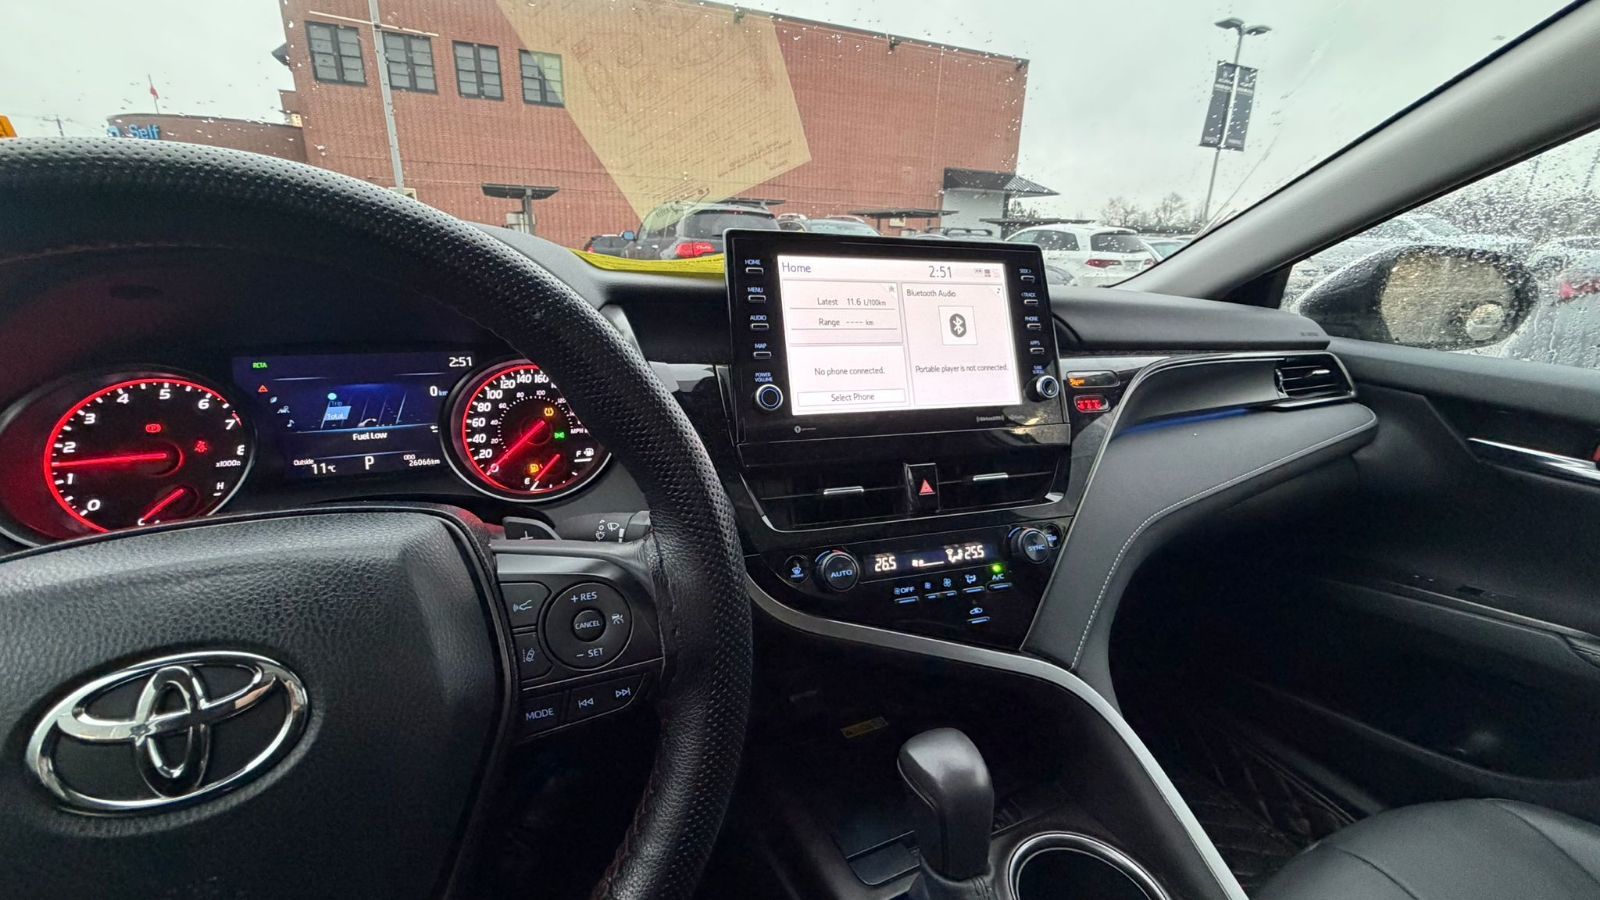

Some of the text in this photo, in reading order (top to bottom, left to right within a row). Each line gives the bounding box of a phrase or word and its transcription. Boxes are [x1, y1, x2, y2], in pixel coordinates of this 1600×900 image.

[129, 124, 160, 139] Self
[782, 262, 812, 273] Home
[928, 265, 952, 278] 2:51
[906, 288, 937, 297] Bluetooth
[817, 297, 887, 307] Latest 11.6 L/100km
[818, 318, 840, 328] Range
[448, 356, 473, 368] 2:51
[814, 366, 886, 377] No phone connected.
[915, 365, 940, 373] Portable
[942, 365, 960, 374] player
[977, 362, 1009, 372] connected.
[516, 374, 532, 384] 140
[534, 374, 550, 384] 160
[500, 380, 516, 389] 120
[116, 393, 130, 404] 4
[159, 388, 171, 400] 5
[486, 390, 503, 400] 100
[831, 392, 876, 402] Select Phone
[198, 399, 210, 410] 6
[477, 402, 492, 412] 80
[84, 412, 96, 424] 3
[472, 418, 486, 427] 60
[225, 419, 236, 430] 7
[352, 432, 370, 440] Fuel
[472, 434, 487, 443] 40
[62, 442, 76, 454] 2
[478, 449, 493, 458] 20
[364, 456, 374, 470] P
[67, 474, 74, 485] 1
[216, 482, 224, 490] H
[87, 500, 100, 511] 0
[830, 569, 853, 578] AUTO
[992, 573, 1005, 581] A/C
[900, 586, 915, 594] OFF
[580, 592, 598, 601] RES
[574, 620, 600, 630] CANCEL
[588, 648, 604, 658] SET
[525, 708, 554, 721] MODE
